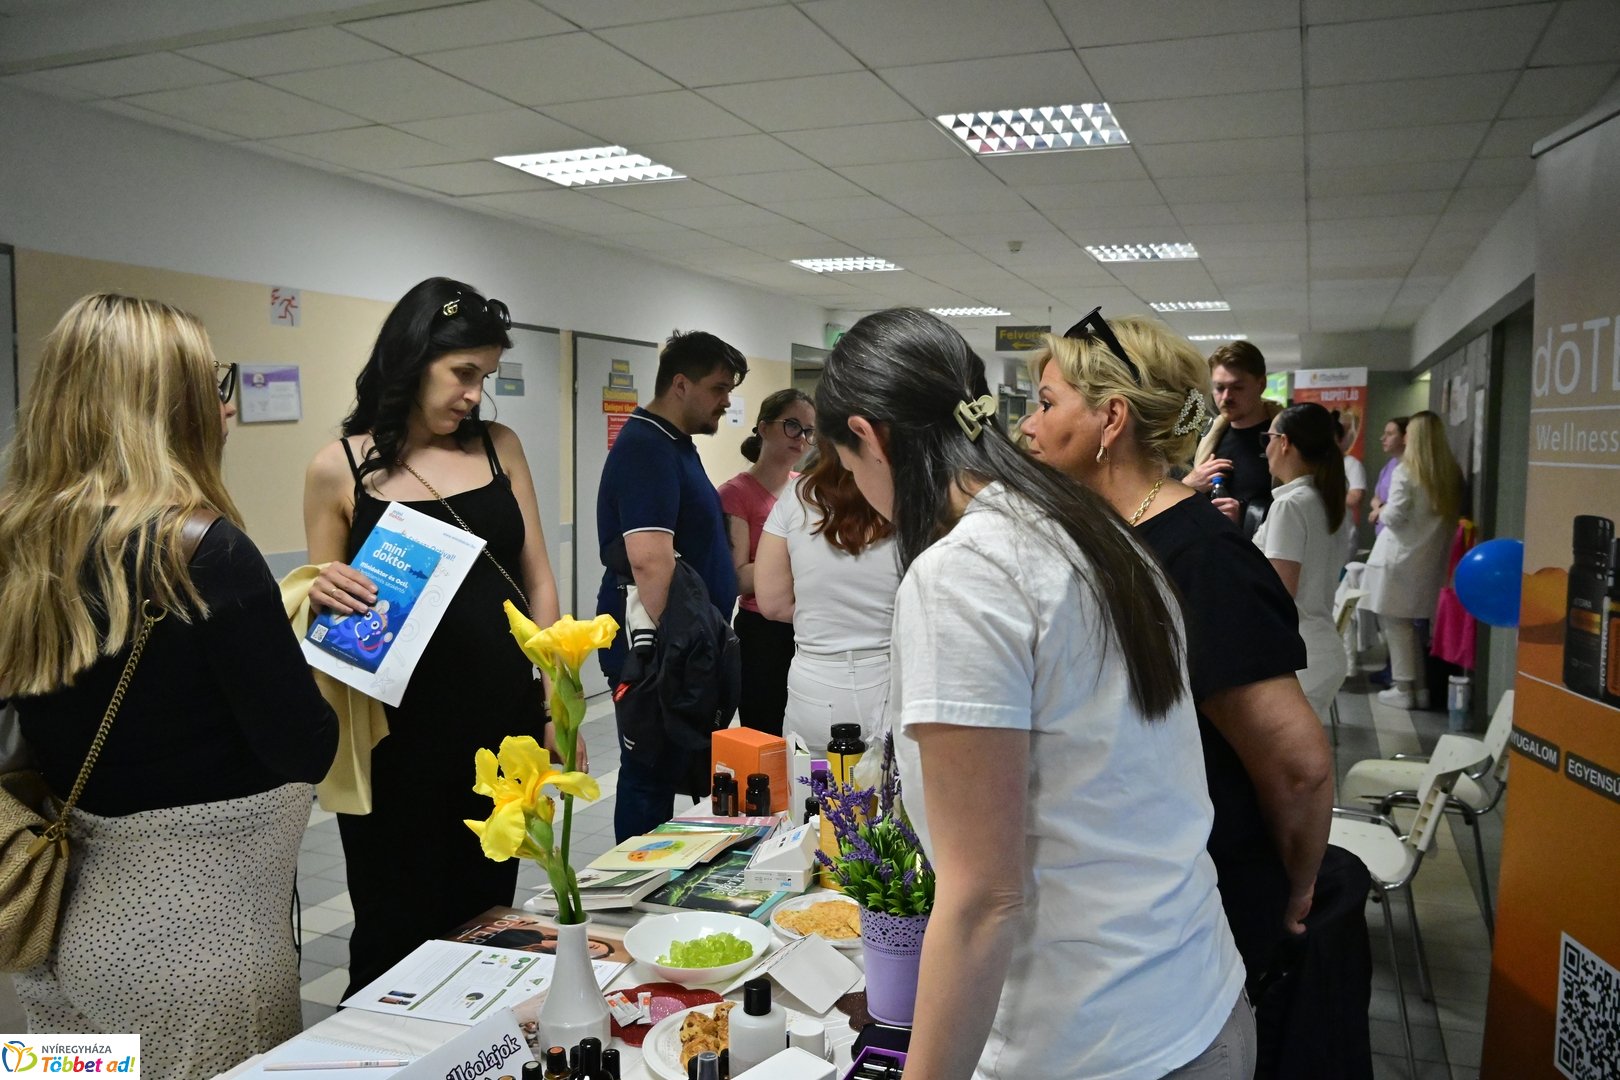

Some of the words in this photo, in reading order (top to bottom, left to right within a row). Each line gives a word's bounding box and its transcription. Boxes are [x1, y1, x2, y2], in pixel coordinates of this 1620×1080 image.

[1536, 422, 1619, 452] Wellness
[373, 549, 411, 571] doktor
[381, 541, 407, 560] mini
[446, 1034, 522, 1080] llóolajok
